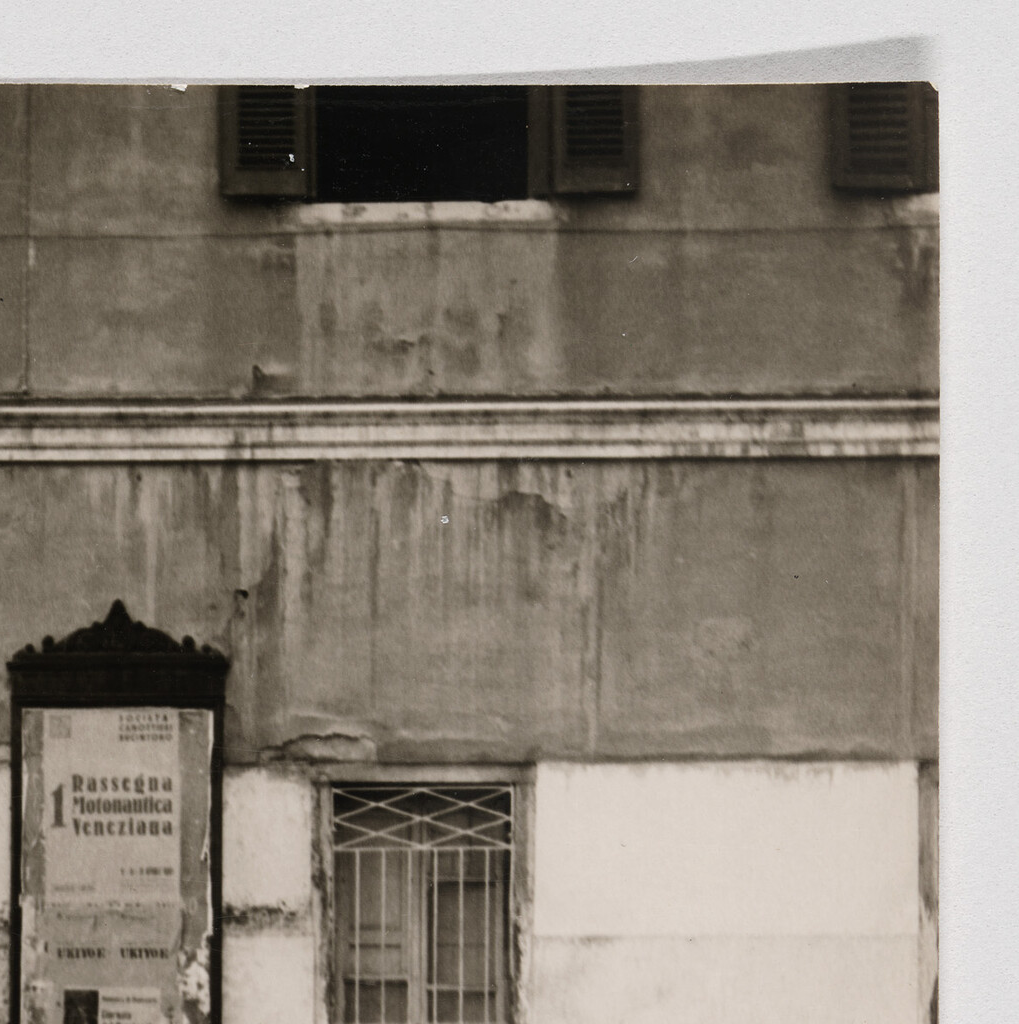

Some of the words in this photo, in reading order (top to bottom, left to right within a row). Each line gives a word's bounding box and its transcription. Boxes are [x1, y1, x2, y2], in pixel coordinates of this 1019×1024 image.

[72, 773, 173, 795] Rassegna
[51, 783, 66, 828] 1
[72, 795, 173, 815] Motonautica
[72, 817, 173, 837] Veneziana
